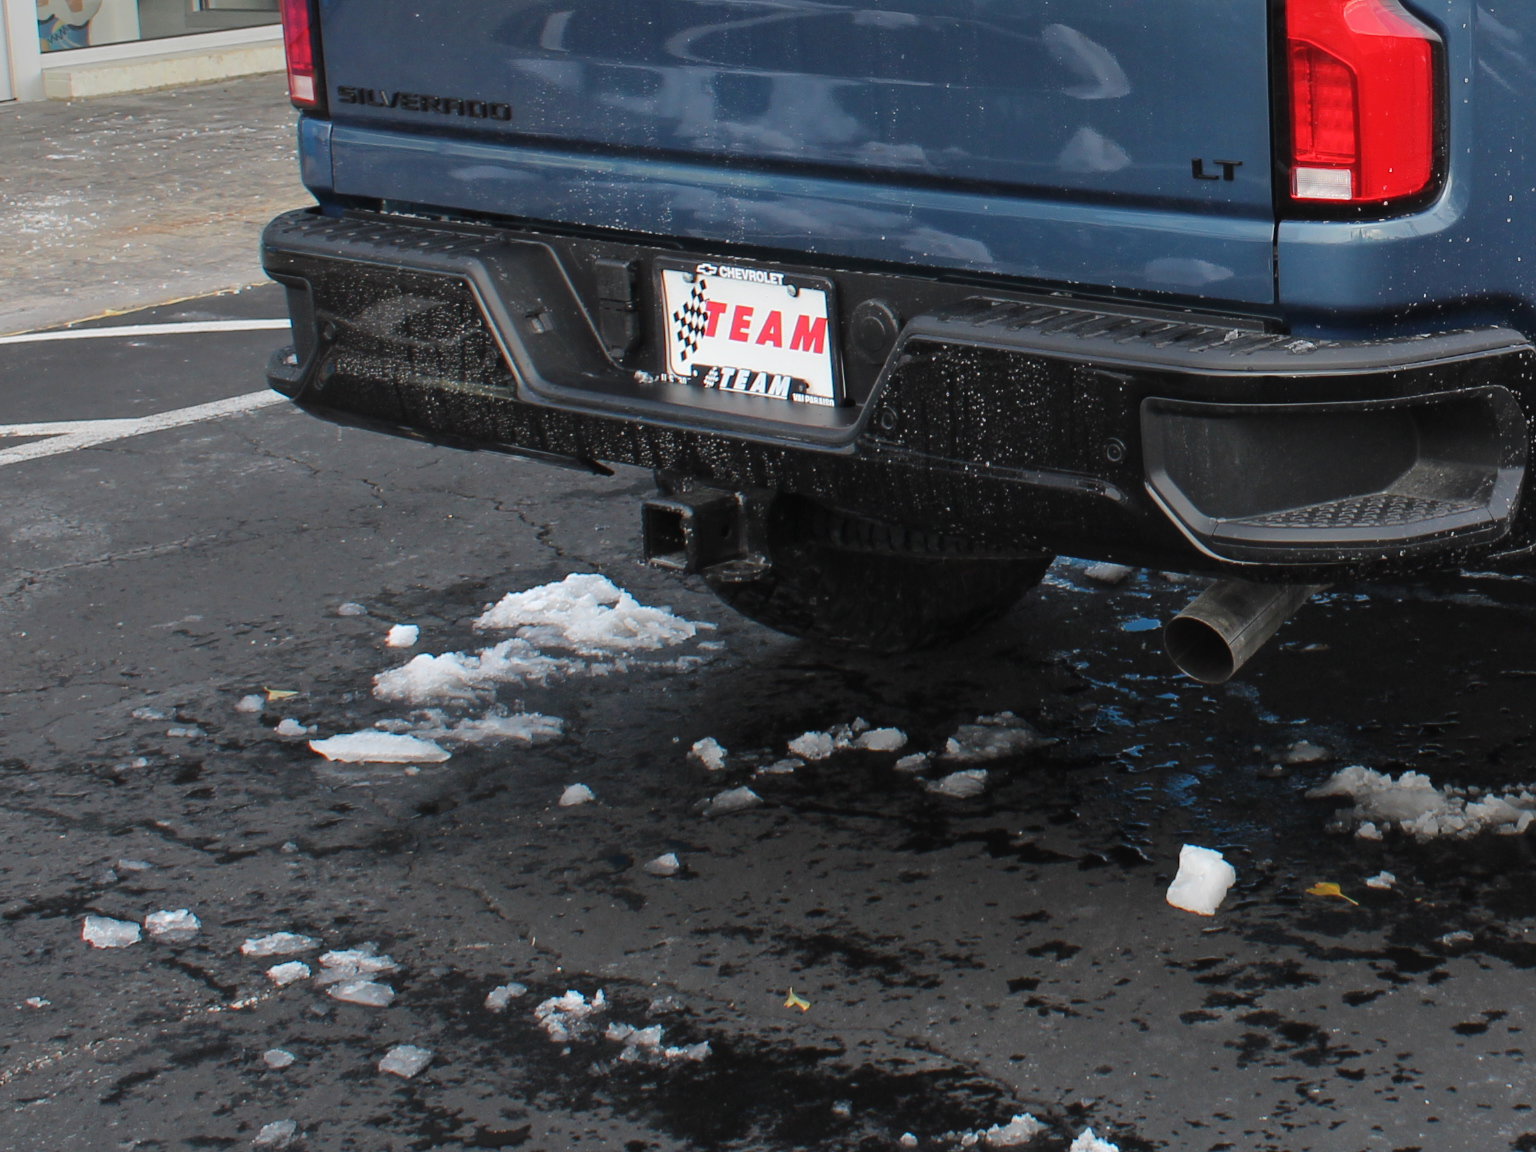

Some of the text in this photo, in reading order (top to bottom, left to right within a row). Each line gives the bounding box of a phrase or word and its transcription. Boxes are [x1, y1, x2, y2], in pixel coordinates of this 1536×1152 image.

[337, 85, 512, 121] SILVERADO
[1191, 158, 1243, 181] LT
[718, 266, 784, 285] CHEVROLET
[705, 301, 828, 354] TEAM
[720, 368, 792, 397] TEAM
